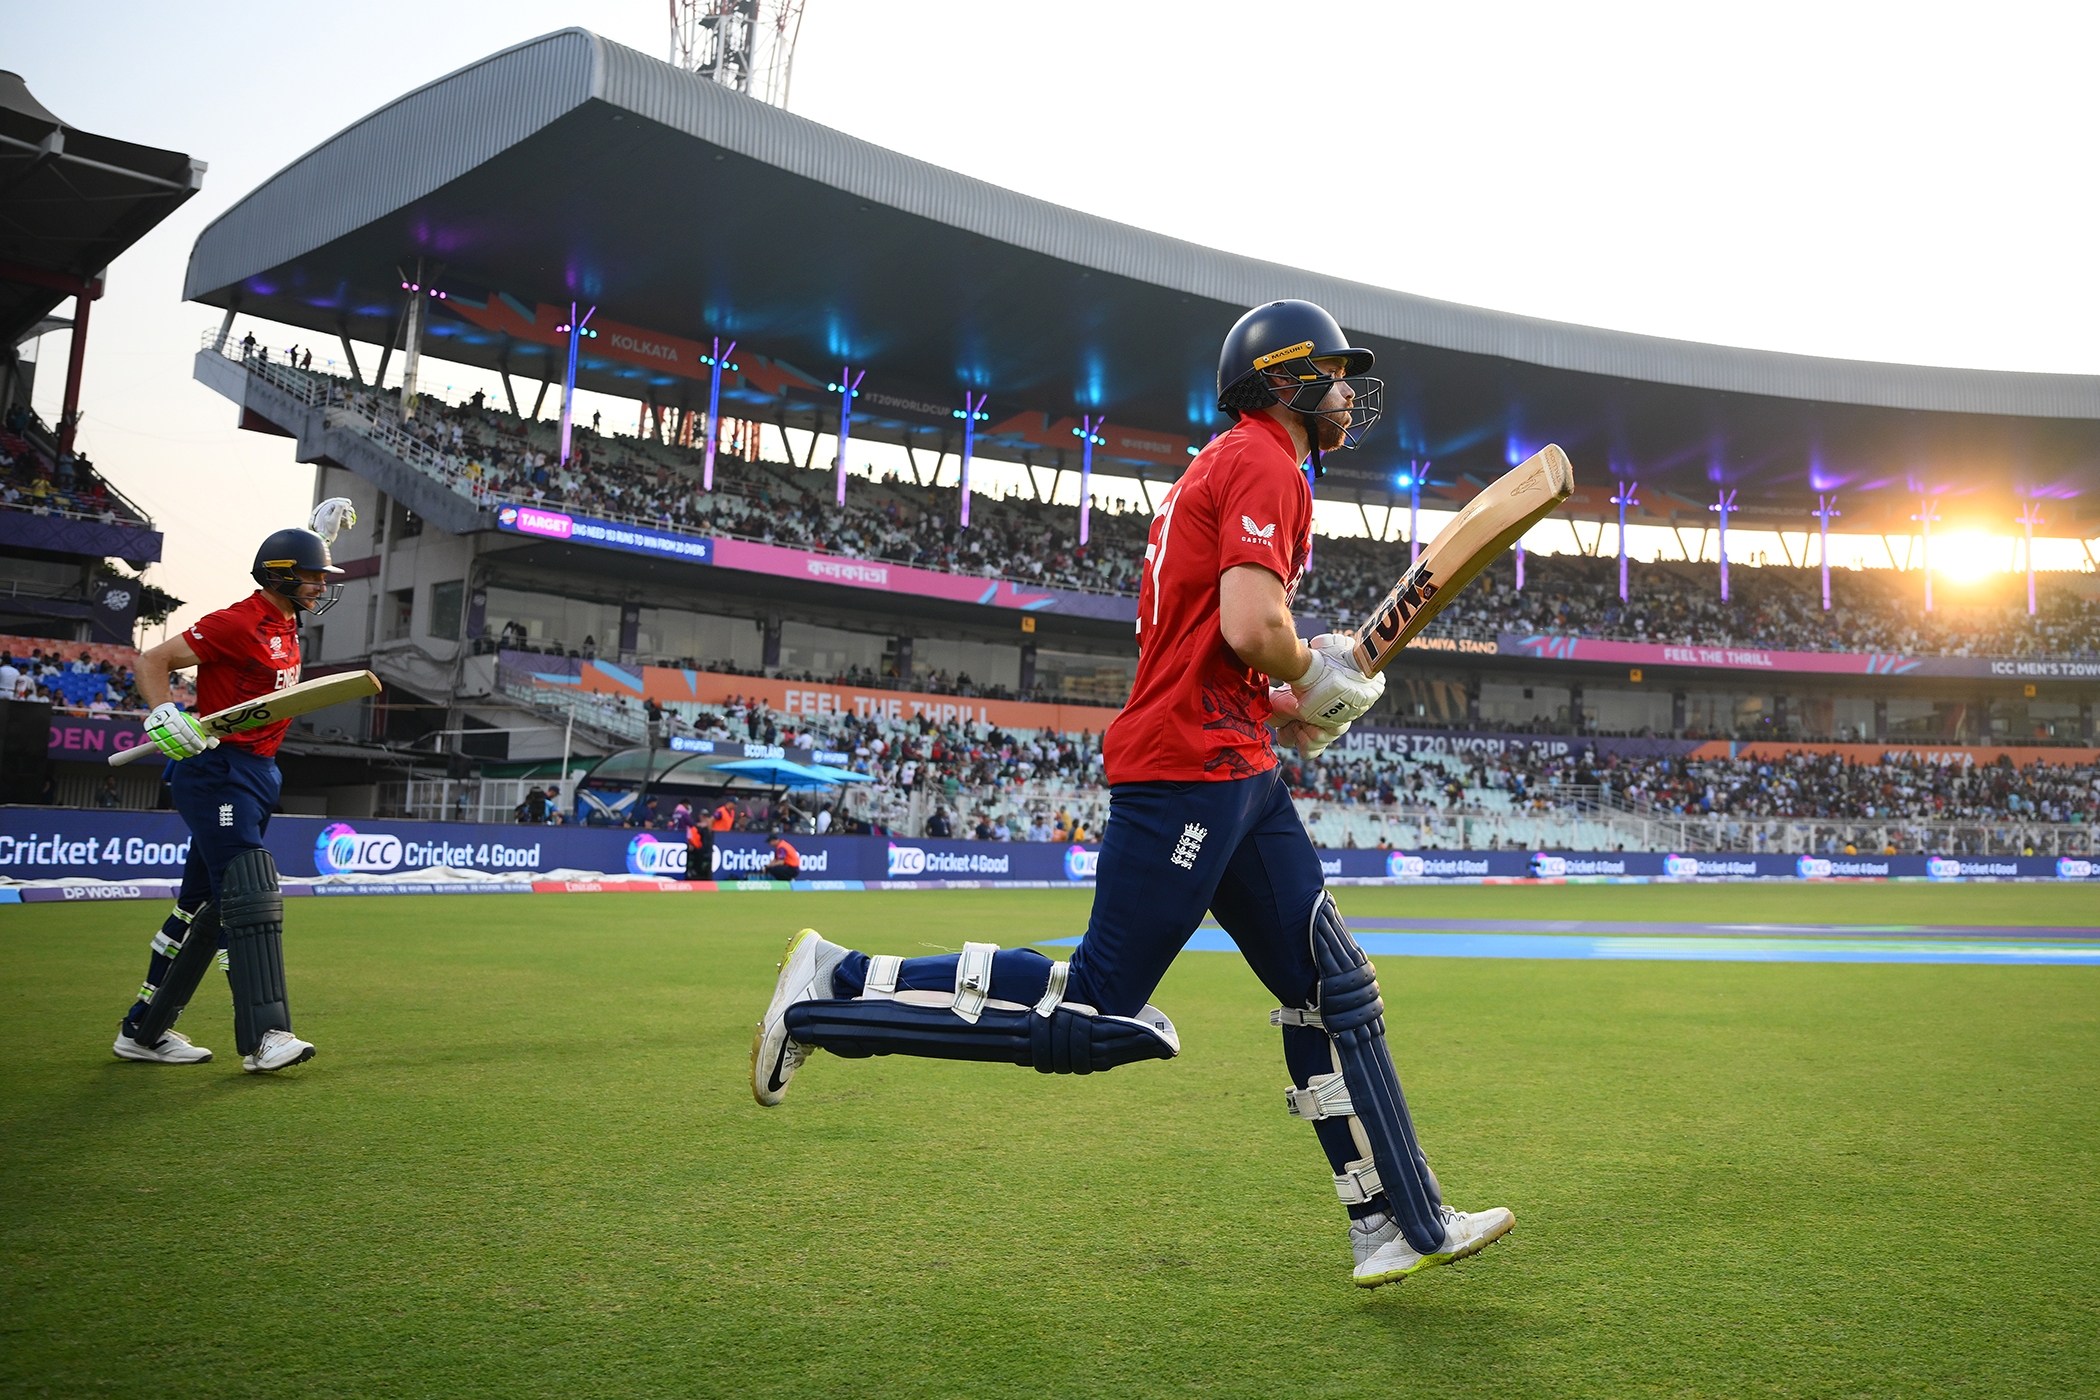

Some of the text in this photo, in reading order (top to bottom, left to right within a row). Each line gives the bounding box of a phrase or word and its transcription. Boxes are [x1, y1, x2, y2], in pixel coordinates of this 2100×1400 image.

[611, 333, 678, 362] KOLKATA
[1271, 345, 1304, 360] MASURI
[521, 513, 570, 533] TARGET
[807, 559, 887, 584] কলকাতা
[1362, 553, 1431, 662] TON
[1458, 639, 1498, 654] STAND
[1664, 648, 1773, 666] FEEL THE THRILL
[274, 663, 301, 690] ENGL
[1991, 662, 2100, 676] ICC MEN'S T20W
[785, 690, 987, 727] FEEL THE THRILL
[1322, 702, 1345, 719] TON
[48, 726, 105, 750] DEN
[1345, 732, 1408, 753] MEN'S
[1411, 736, 1447, 752] T20
[743, 743, 785, 759] SCOTLAND
[0, 834, 193, 864] Cricket 4 Good
[357, 841, 396, 864] ICC
[405, 841, 540, 867] Cricket 4 Good
[796, 850, 827, 871] ood
[896, 853, 922, 869] ICC
[926, 852, 1009, 873] Cricket 4 Good
[1321, 858, 1342, 875] ood
[1402, 860, 1422, 872] ICC
[1424, 859, 1488, 874] Cricket 4 Good
[1546, 861, 1563, 872] ICC
[1566, 860, 1595, 874] Cricket
[1602, 860, 1625, 874] Good
[63, 886, 141, 899] DP WORLD
[565, 881, 602, 892] Emirates
[657, 881, 693, 892] Emirates
[737, 880, 771, 890] aramco
